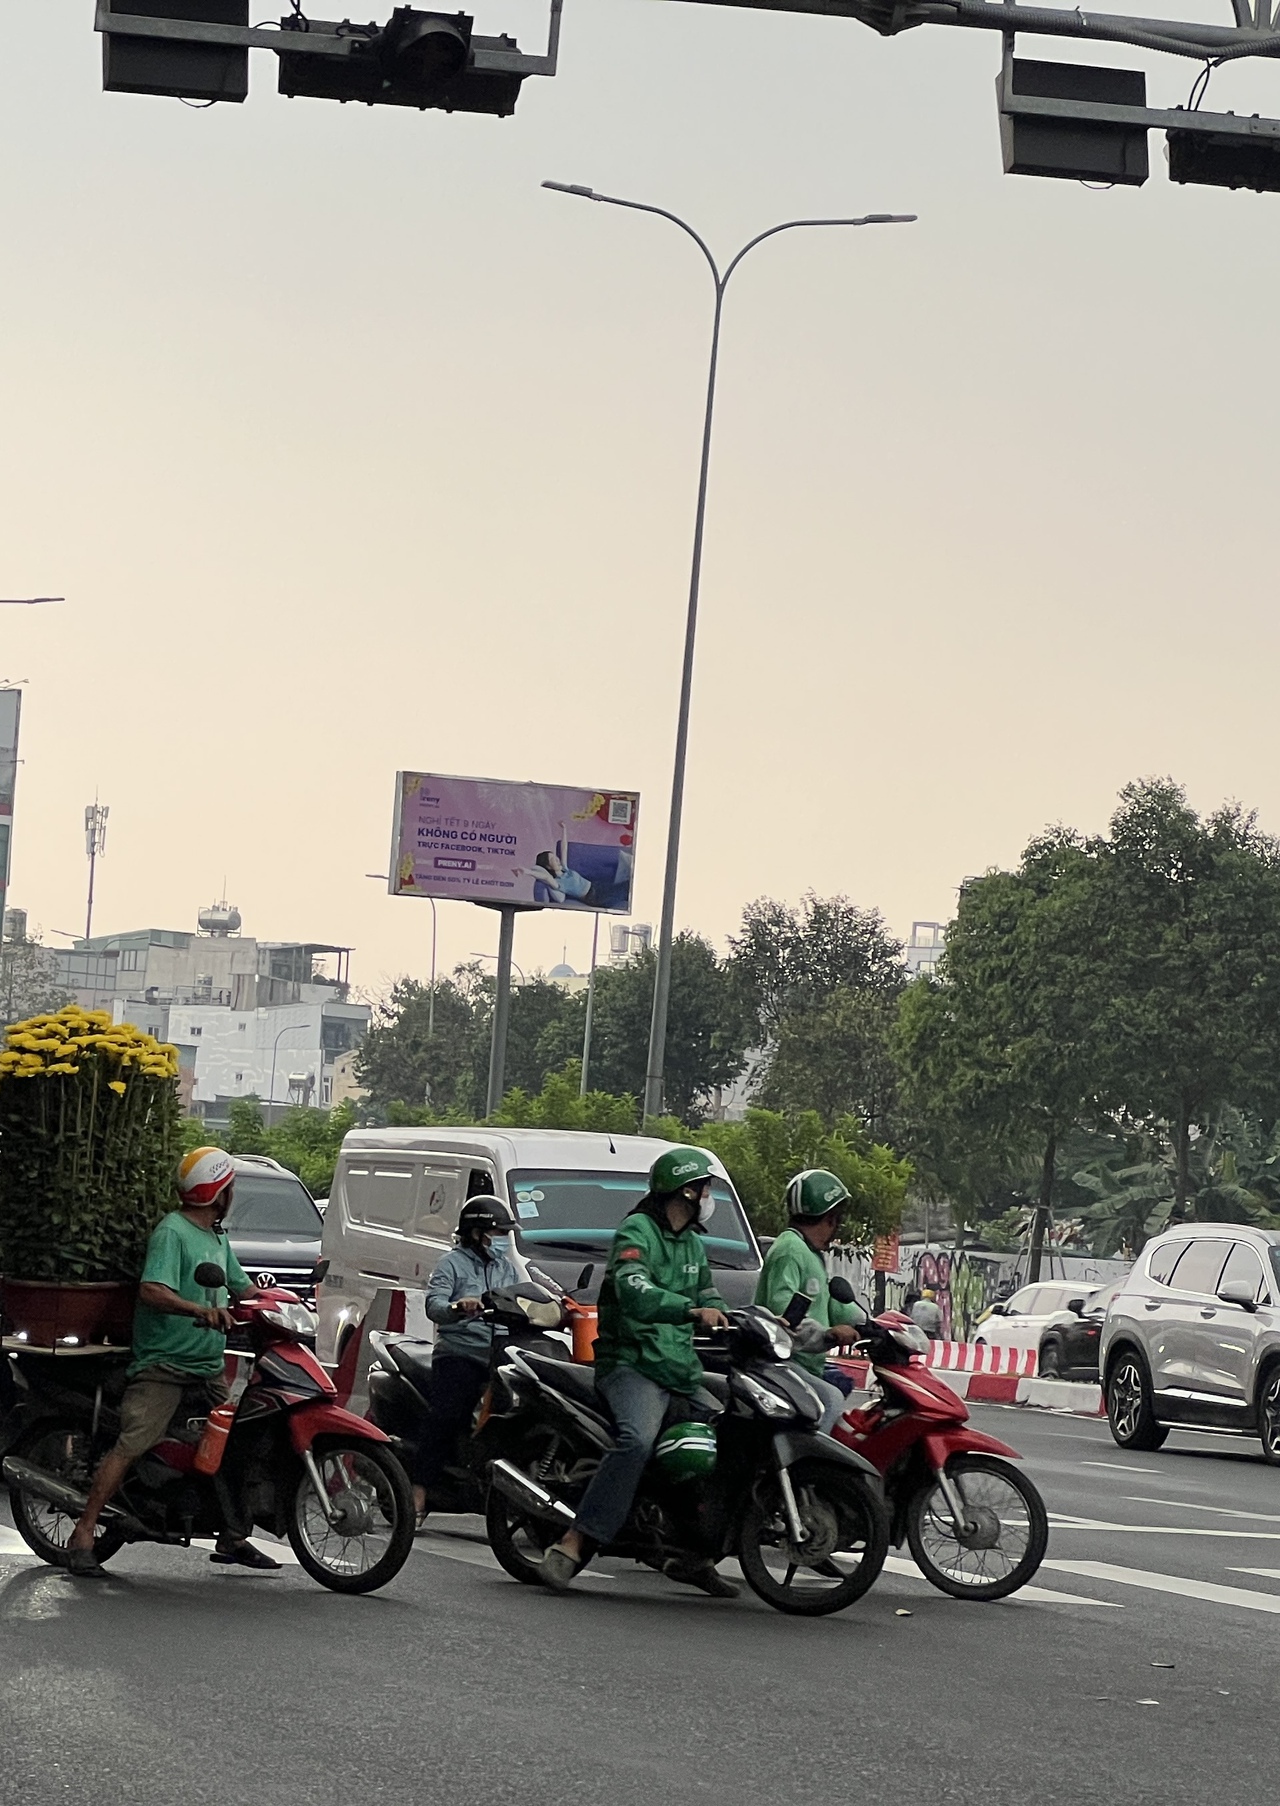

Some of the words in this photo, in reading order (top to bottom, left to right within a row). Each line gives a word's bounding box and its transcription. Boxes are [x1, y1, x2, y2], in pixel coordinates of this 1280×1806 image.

[445, 817, 461, 828] TẾT
[417, 827, 458, 840] KHÔNG
[461, 830, 477, 842] CÓ
[480, 833, 517, 845] NGƯỜI
[441, 843, 485, 854] FACEBOOK,
[487, 847, 515, 856] TIKTOK
[438, 860, 472, 869] PRENY.AI
[672, 1161, 699, 1176] Grab
